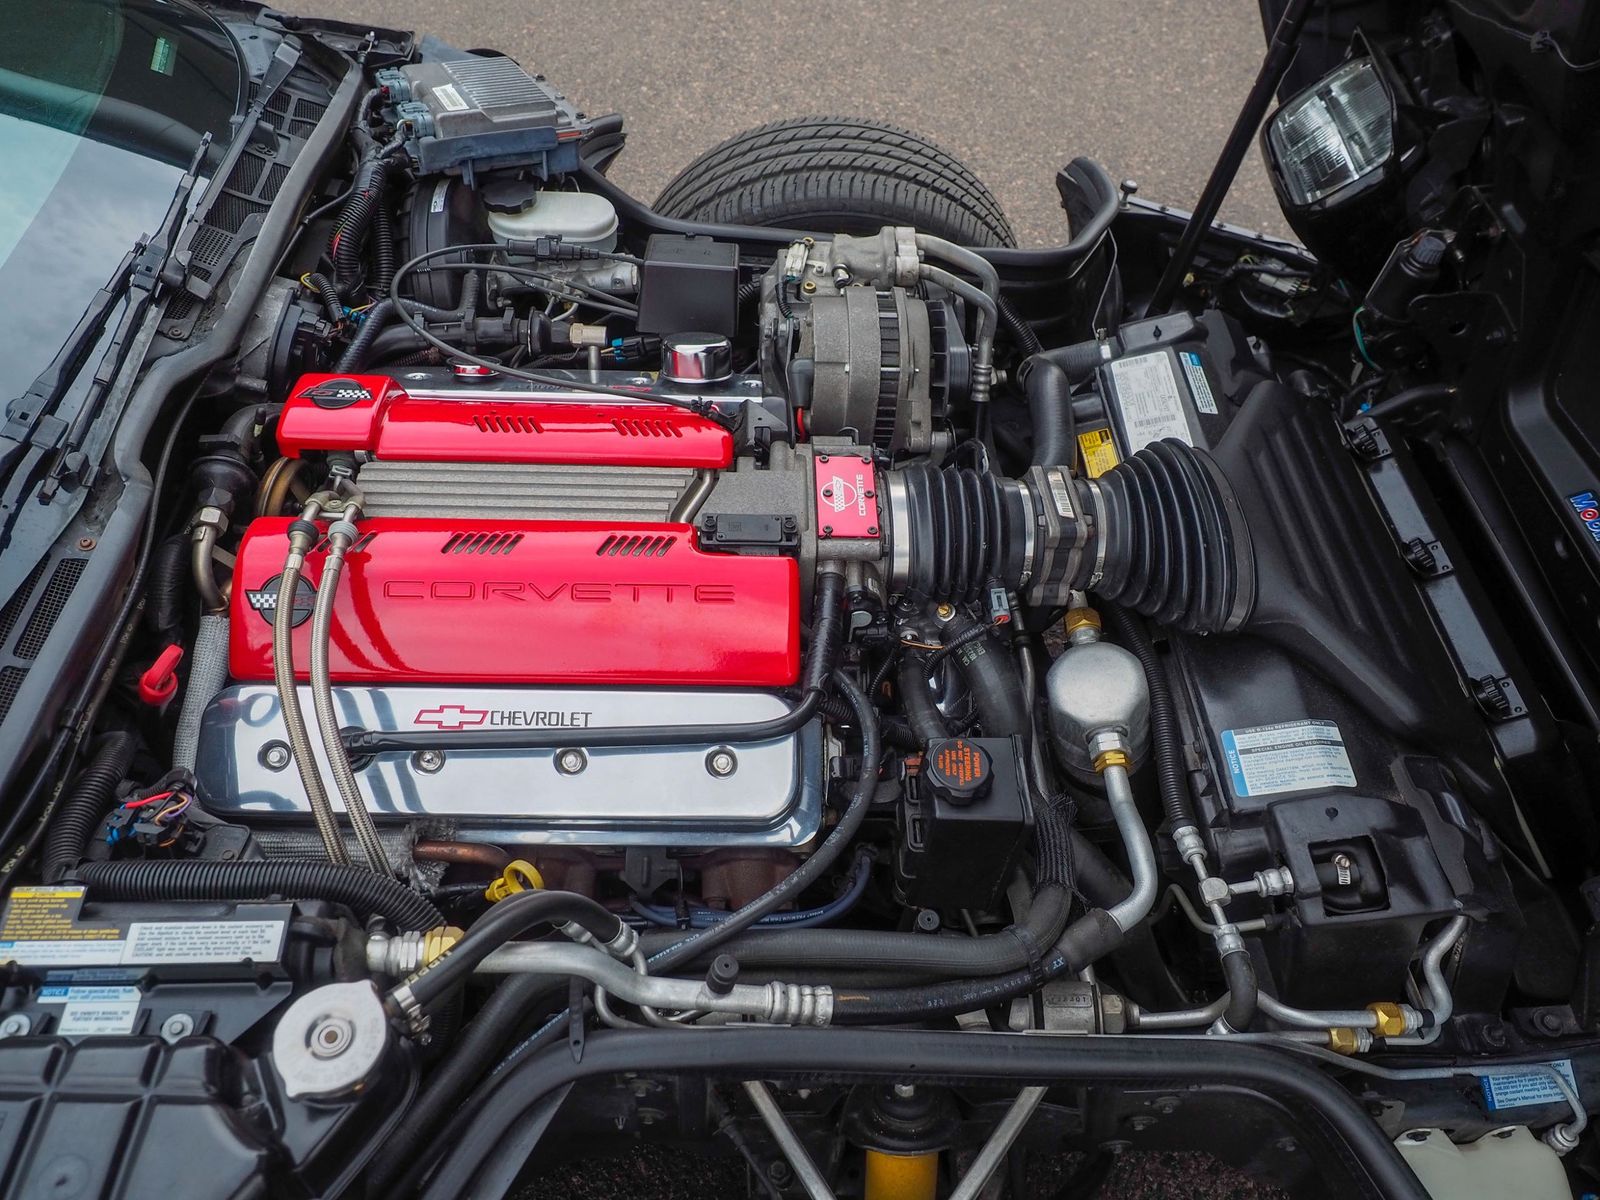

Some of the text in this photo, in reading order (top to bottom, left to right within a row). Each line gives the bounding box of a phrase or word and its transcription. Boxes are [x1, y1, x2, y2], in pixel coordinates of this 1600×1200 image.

[856, 474, 866, 516] CORVETTE
[383, 581, 735, 602] CORVETTE
[490, 710, 593, 727] CHEVROLET
[1228, 750, 1240, 774] NOTICE
[42, 988, 66, 996] NOTICE
